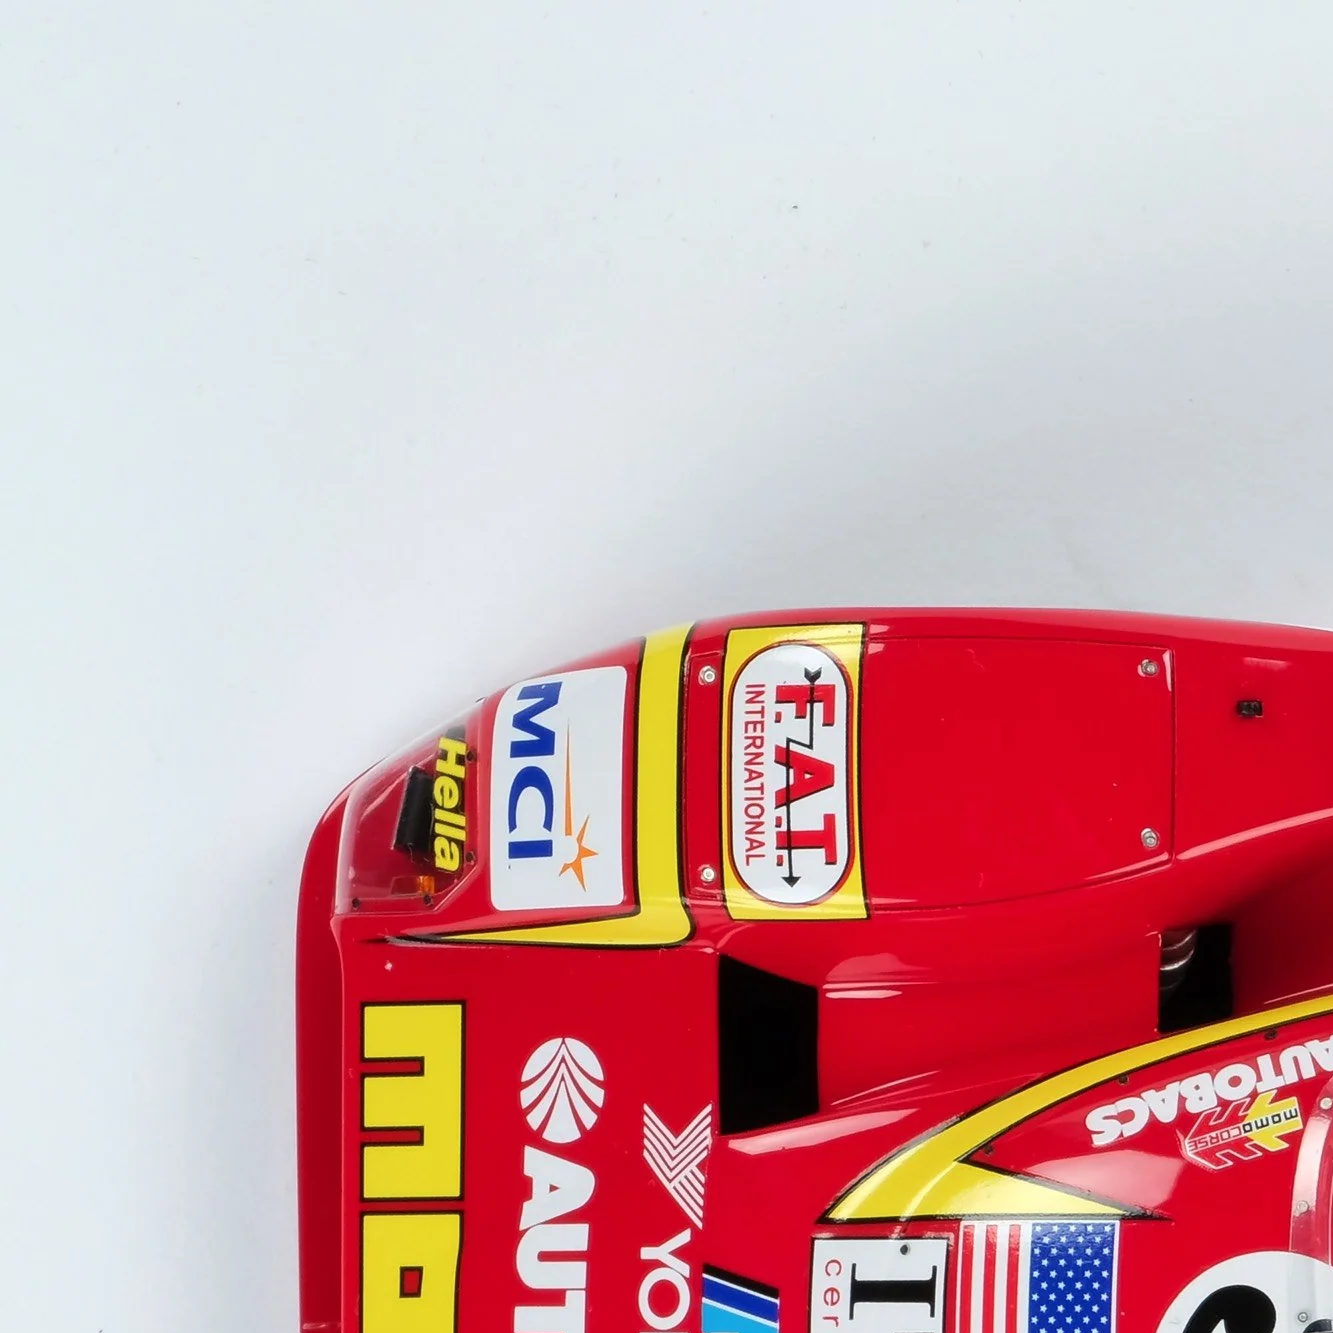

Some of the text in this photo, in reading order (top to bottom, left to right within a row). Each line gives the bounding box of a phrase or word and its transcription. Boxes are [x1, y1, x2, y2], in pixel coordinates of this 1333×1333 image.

[433, 735, 467, 872] Hella
[506, 680, 564, 861] MCI
[744, 682, 766, 867] INTERNATIONAL
